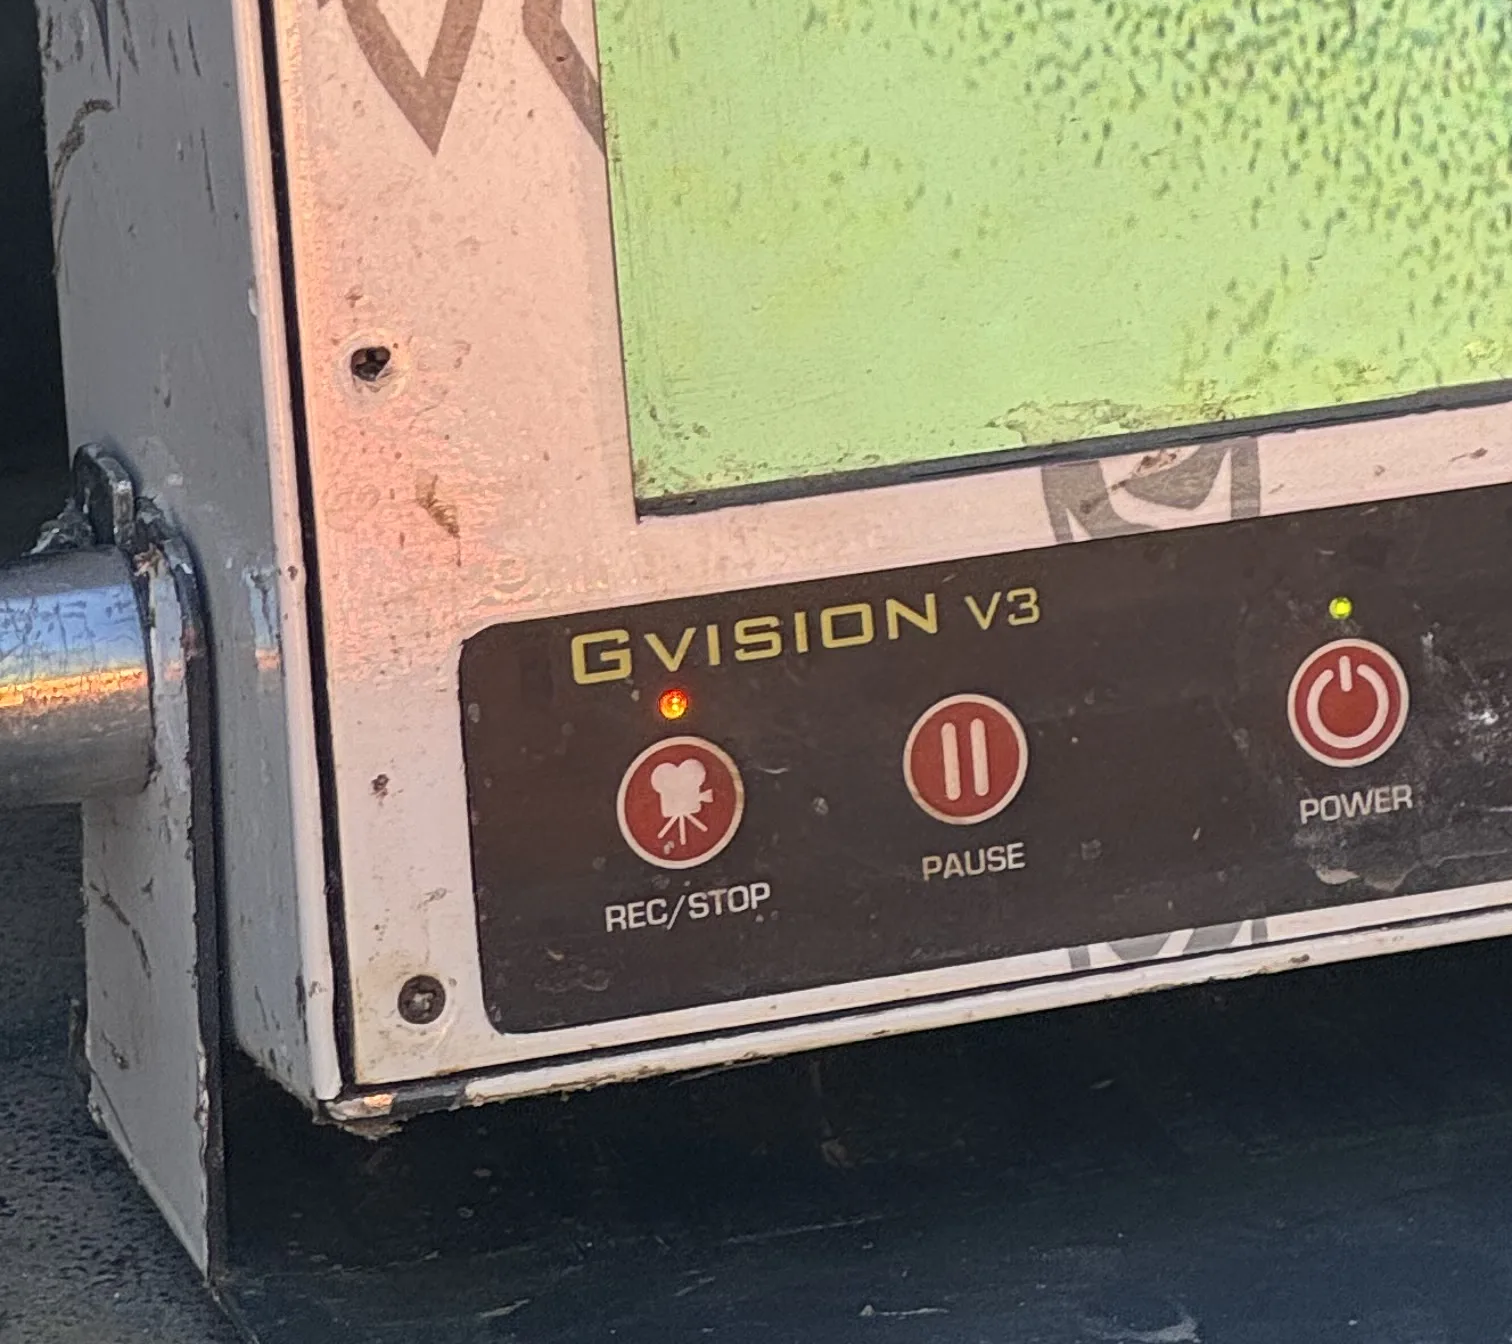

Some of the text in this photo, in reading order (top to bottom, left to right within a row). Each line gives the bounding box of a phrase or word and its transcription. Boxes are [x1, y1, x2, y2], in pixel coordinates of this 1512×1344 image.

[570, 585, 1042, 685] GVISION V3
[1298, 784, 1415, 826] POWER
[921, 842, 1027, 883] PAUSE
[604, 881, 772, 935] REC/STOP
